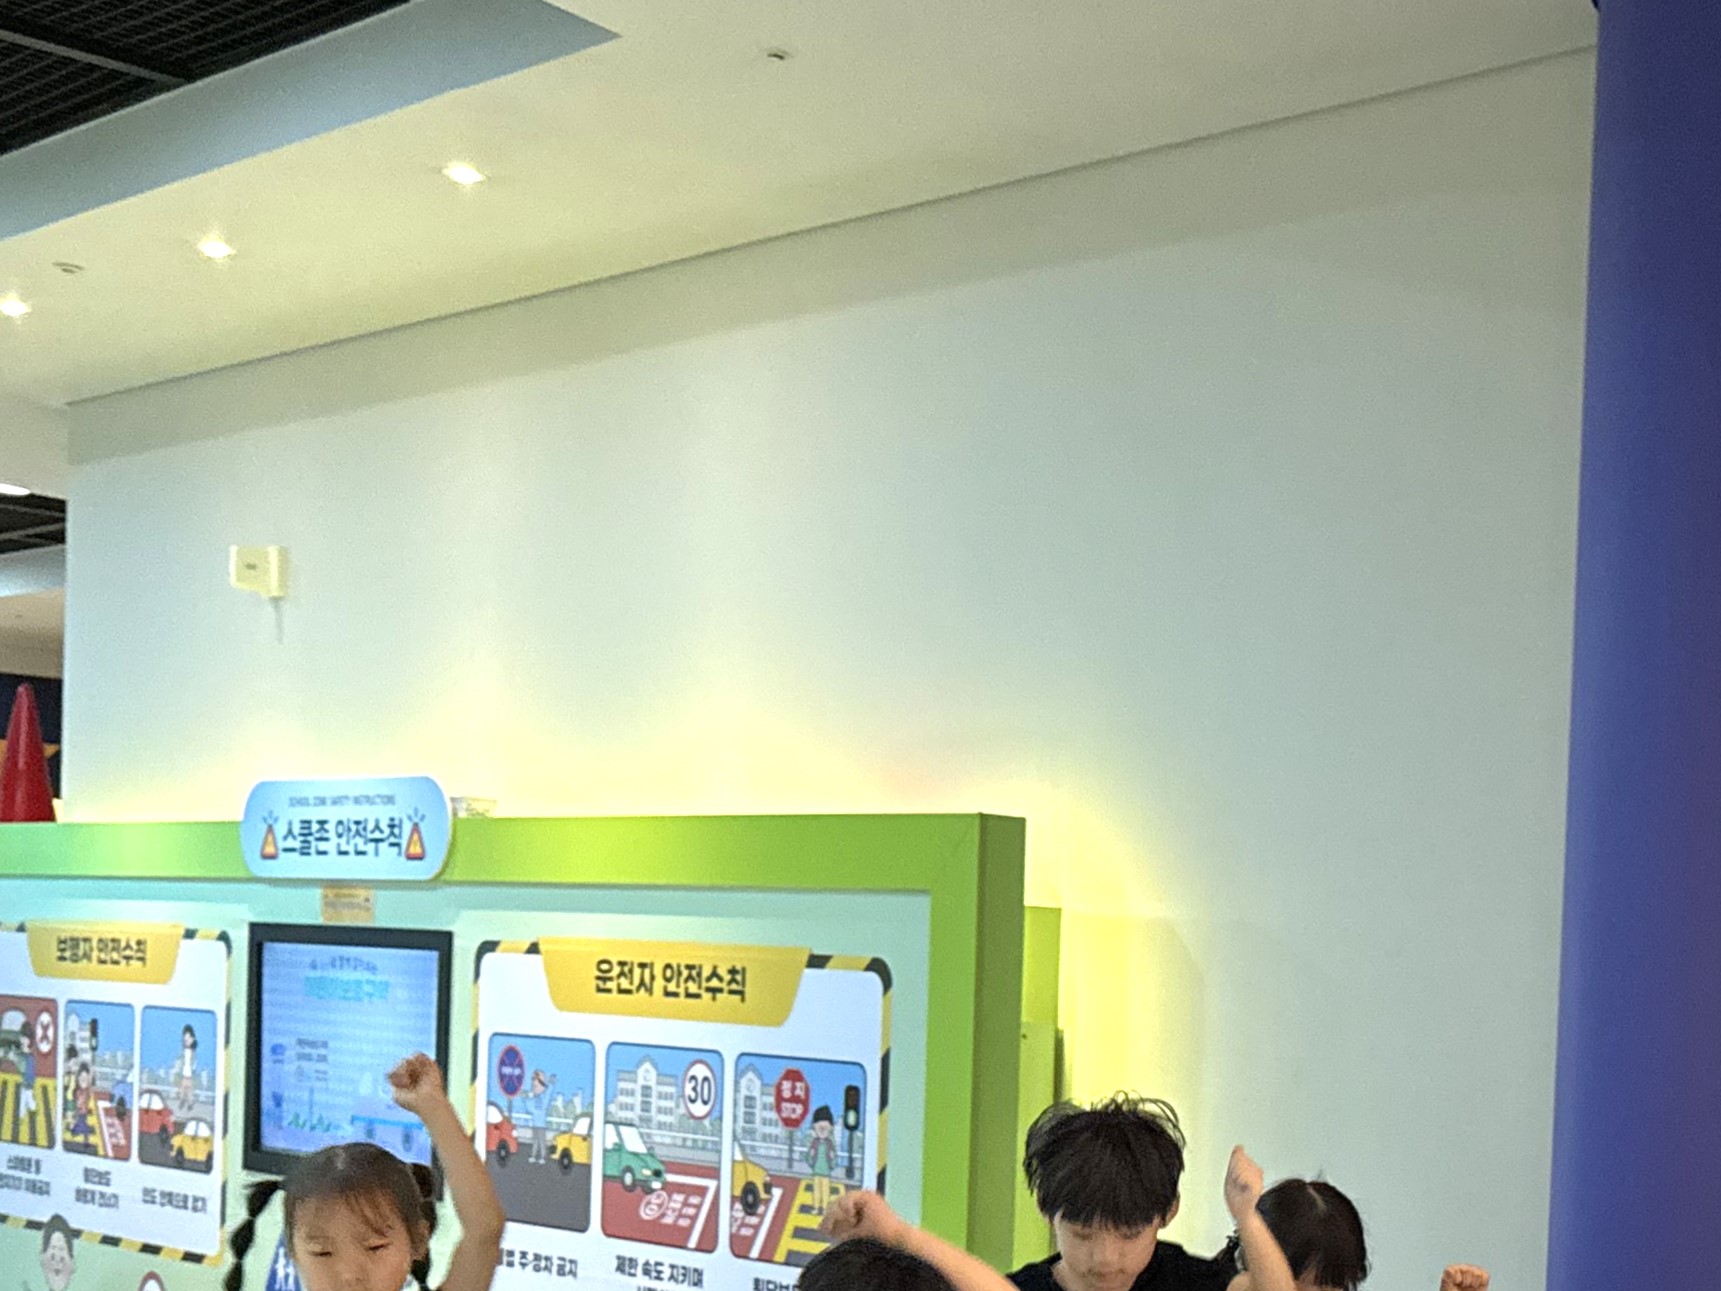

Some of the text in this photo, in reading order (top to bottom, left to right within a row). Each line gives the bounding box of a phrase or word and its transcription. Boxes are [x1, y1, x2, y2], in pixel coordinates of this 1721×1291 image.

[282, 817, 403, 857] 스쿨존 안전수칙
[97, 937, 147, 967] 안전수칙
[595, 958, 747, 1003] 운전자 안전수칙
[687, 1075, 711, 1106] 30
[780, 1101, 804, 1119] STOP
[556, 1256, 579, 1280] 금지
[614, 1254, 704, 1288] 제한 속도 지키며
